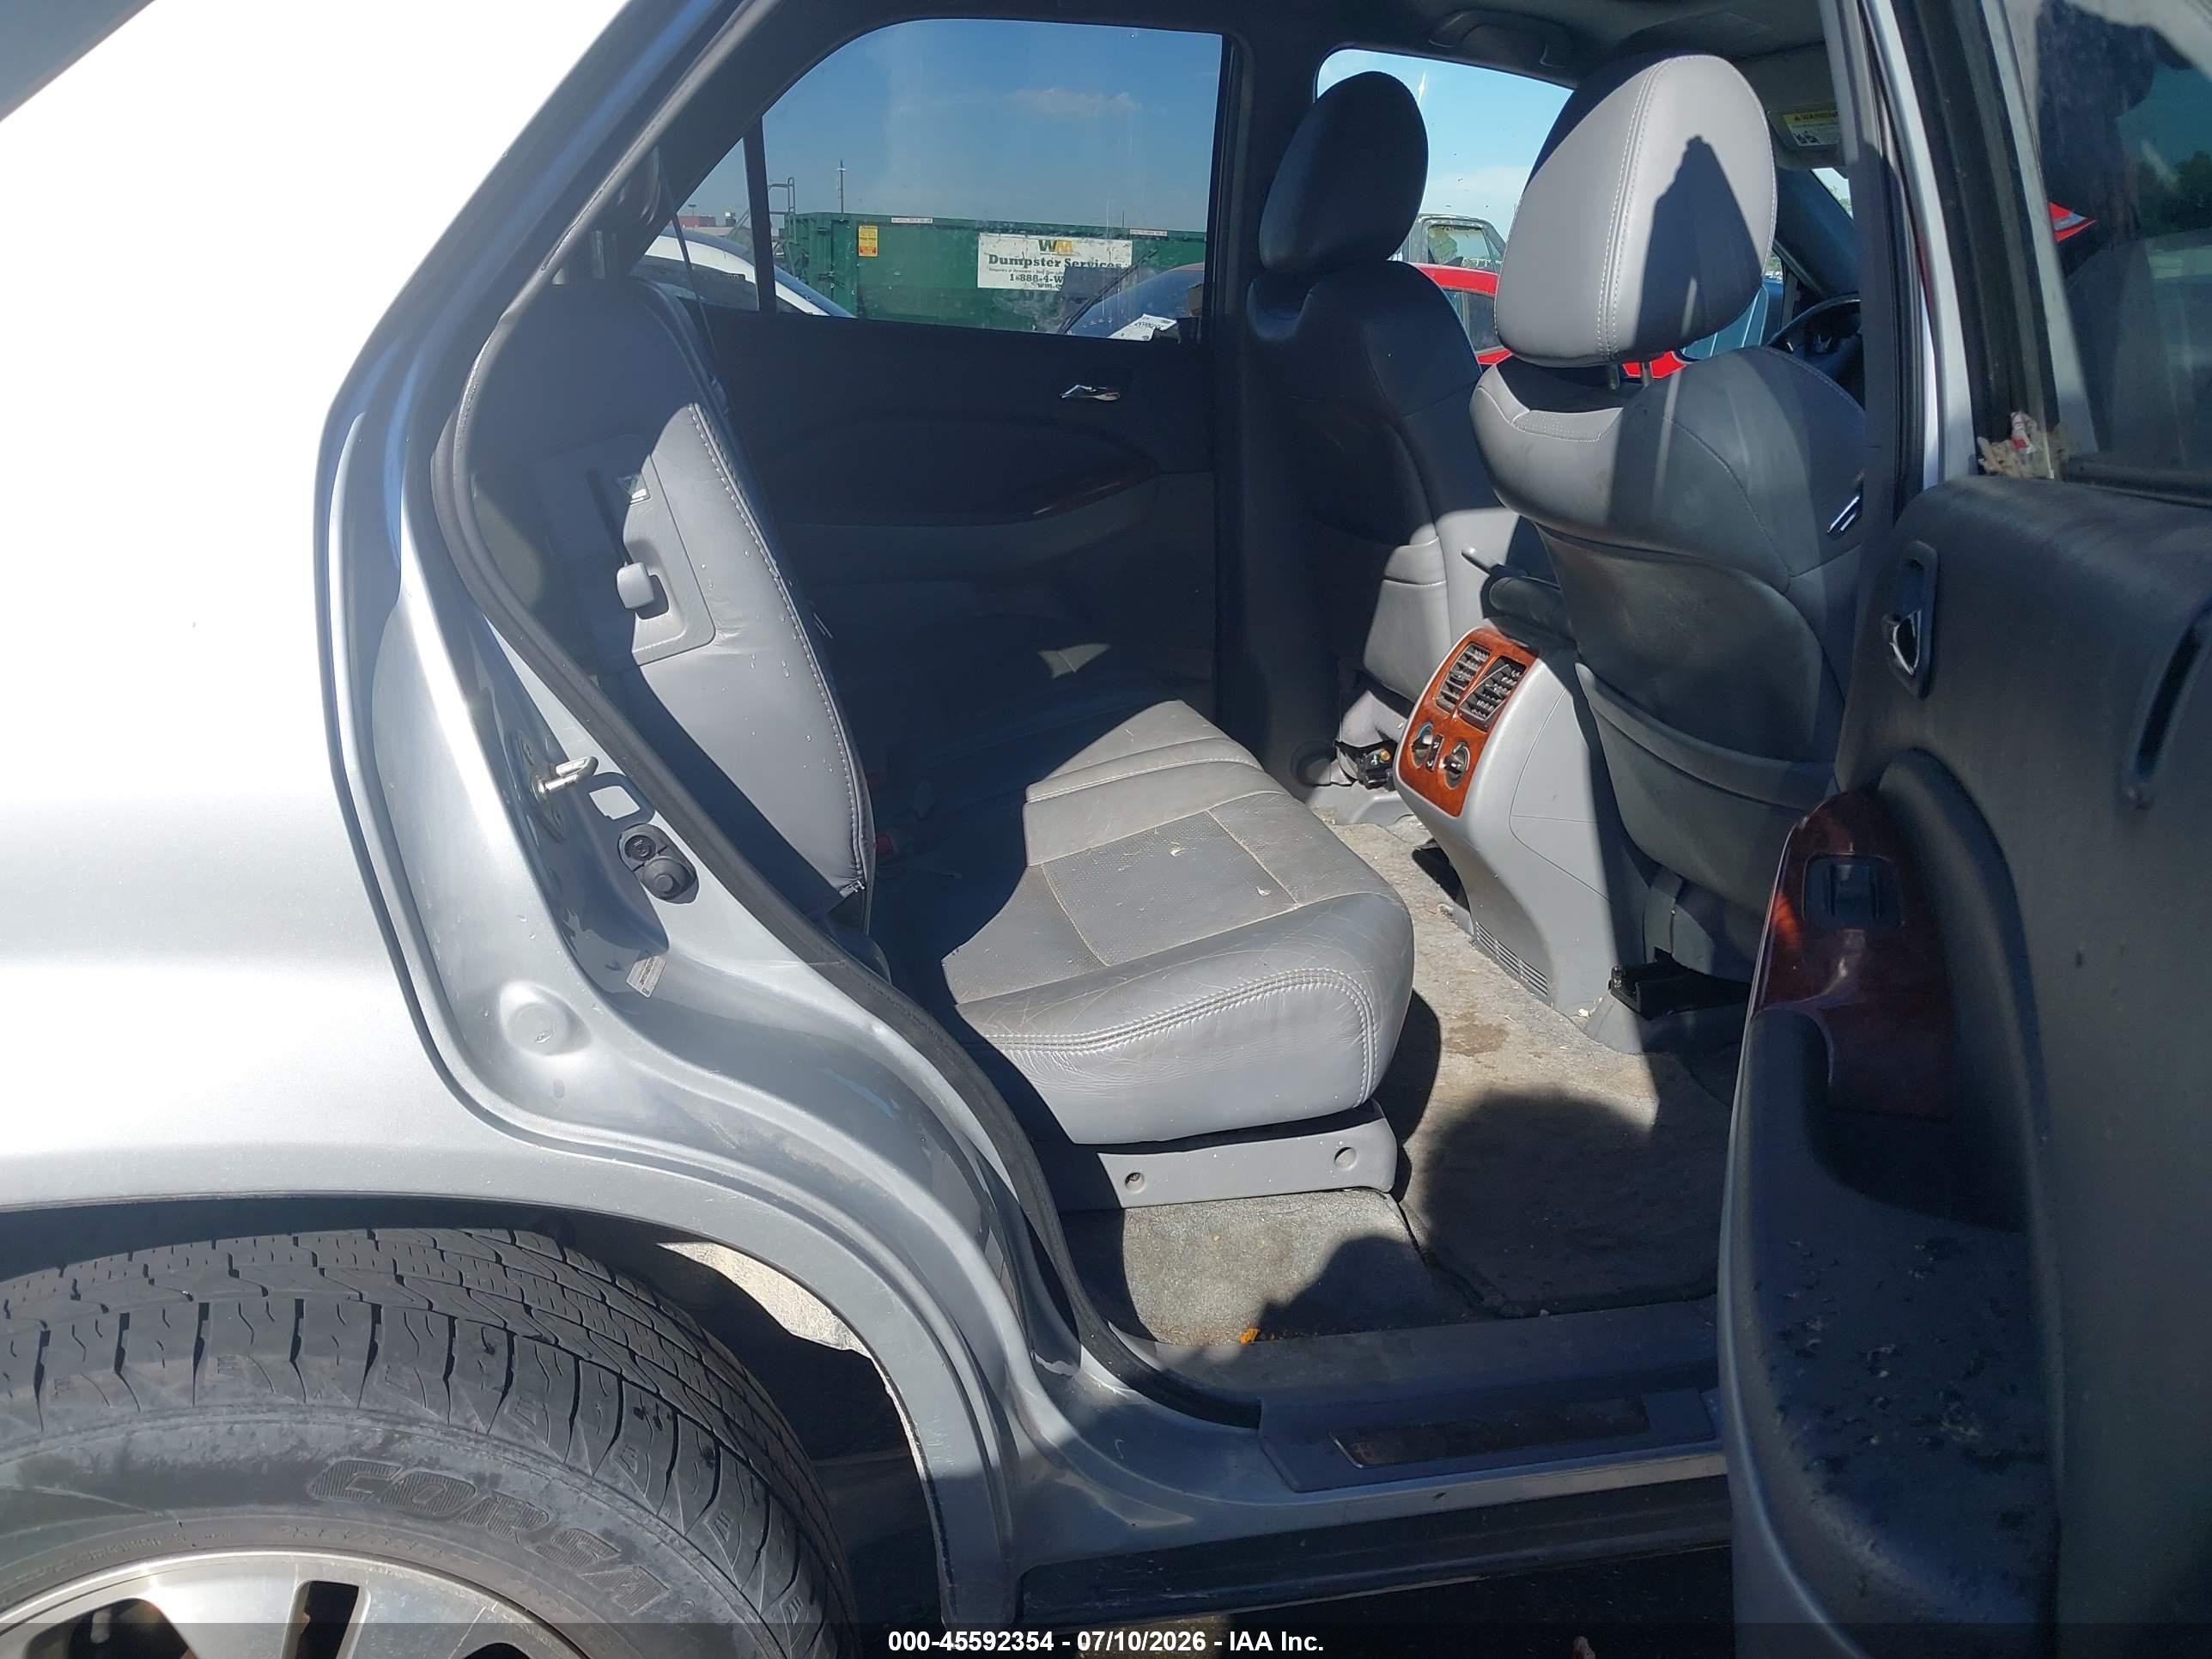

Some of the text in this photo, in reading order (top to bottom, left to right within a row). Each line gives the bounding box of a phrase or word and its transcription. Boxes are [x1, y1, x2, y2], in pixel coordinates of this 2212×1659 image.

[1038, 240, 1073, 253] WM
[988, 253, 1061, 268] Dumpster
[1009, 273, 1064, 284] 1-888-4-W
[306, 1459, 672, 1616] CORSA
